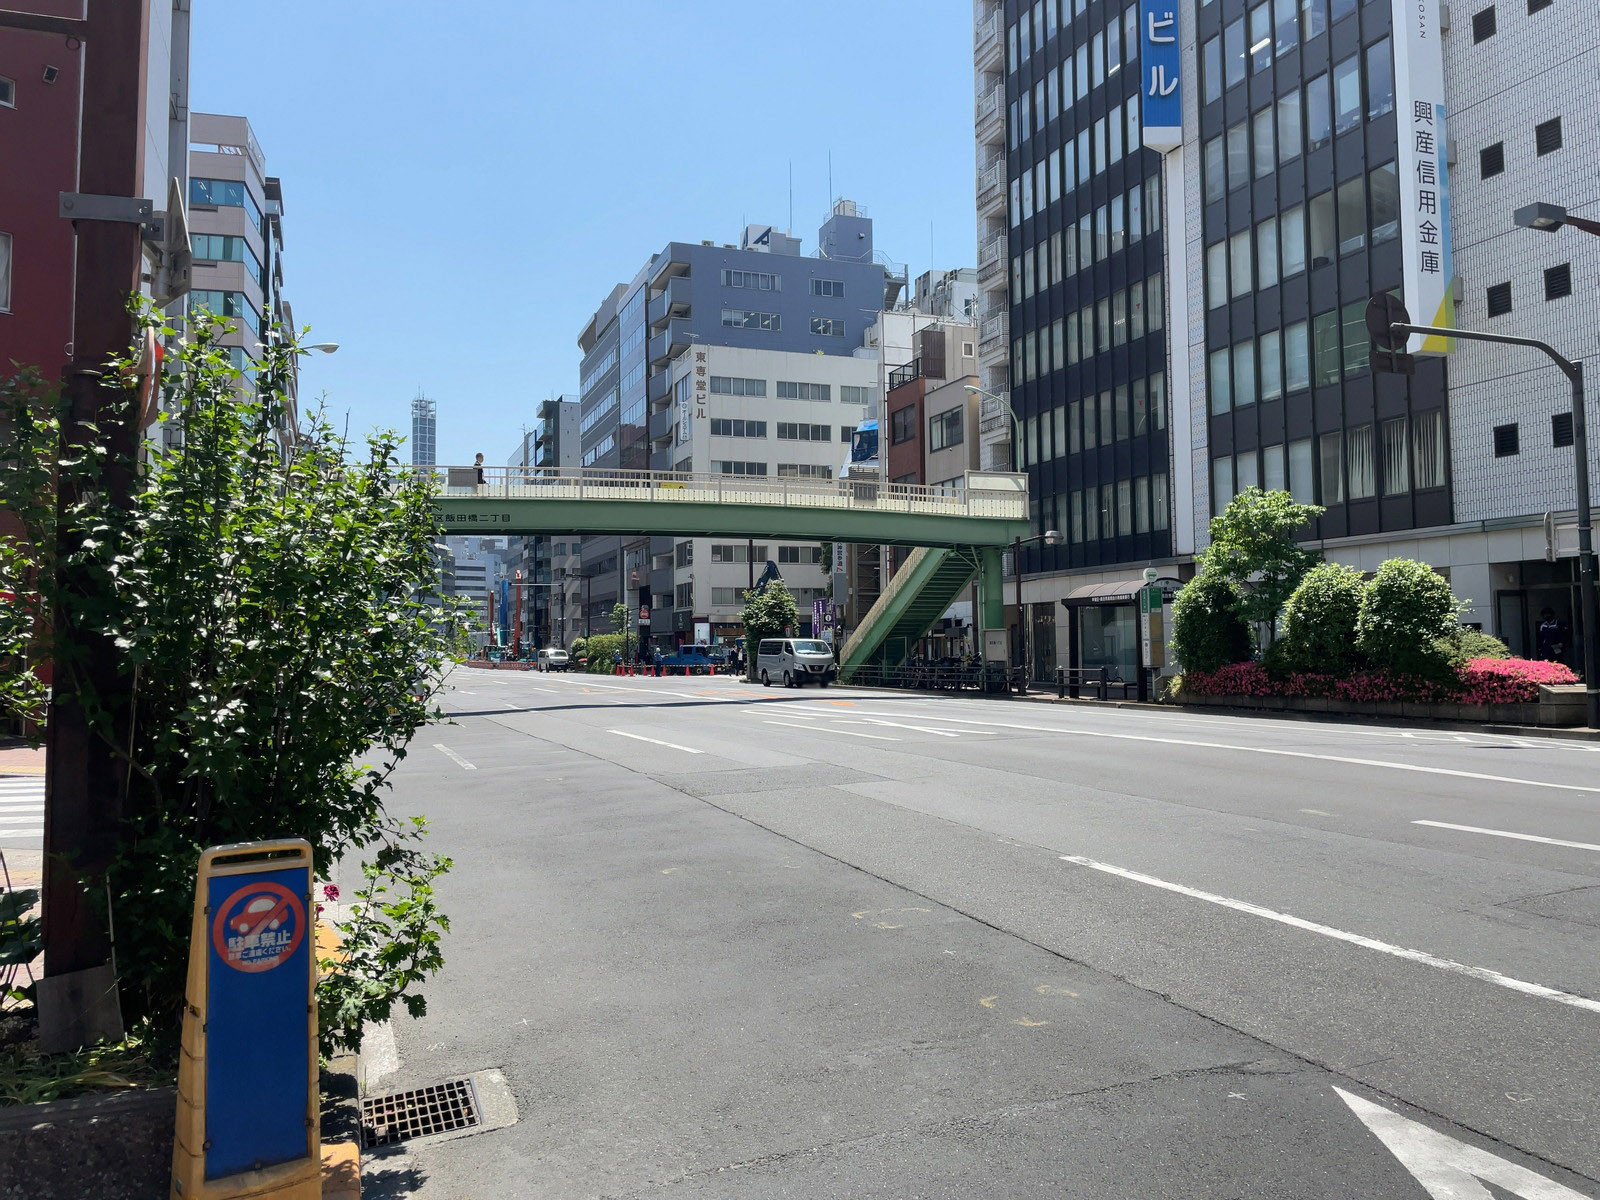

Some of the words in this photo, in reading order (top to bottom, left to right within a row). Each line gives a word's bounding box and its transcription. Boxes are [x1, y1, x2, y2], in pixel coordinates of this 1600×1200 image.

[1148, 11, 1178, 96] ビル
[1413, 100, 1440, 275] 興産信用金庫
[695, 351, 707, 419] 東専堂ビル
[229, 930, 291, 951] 駐車禁止
